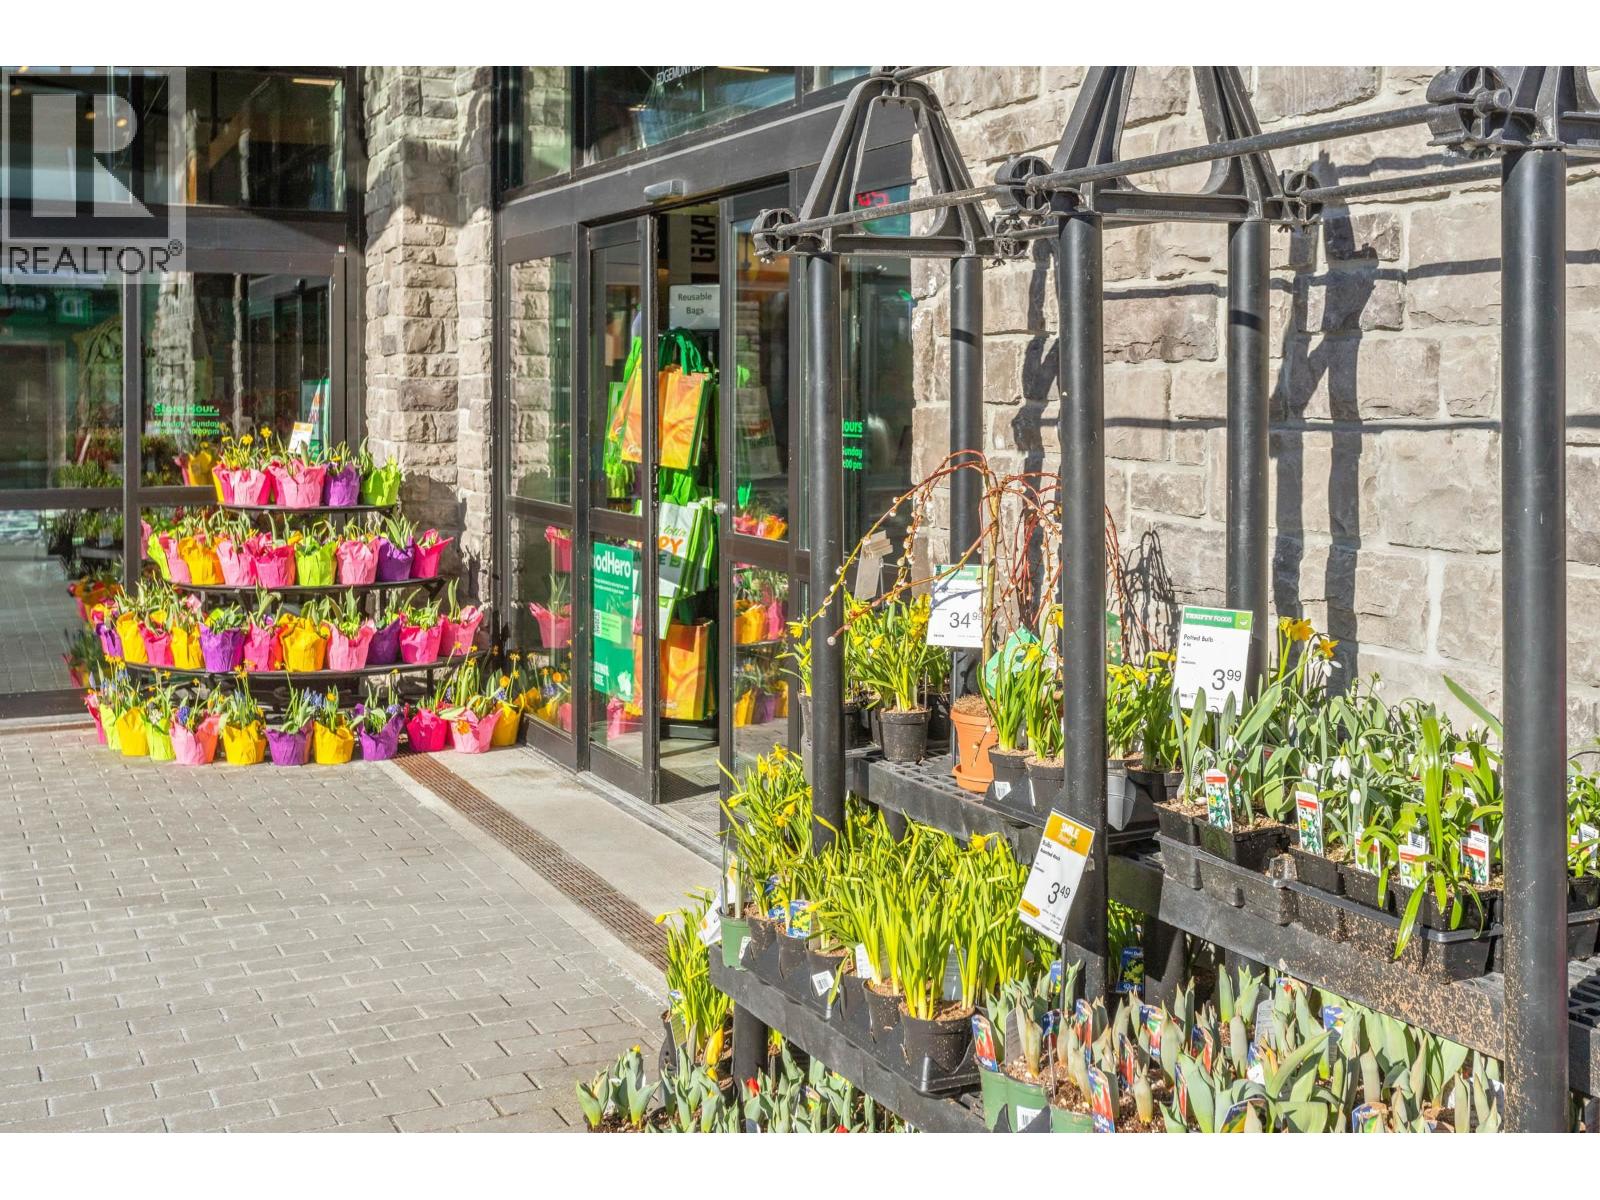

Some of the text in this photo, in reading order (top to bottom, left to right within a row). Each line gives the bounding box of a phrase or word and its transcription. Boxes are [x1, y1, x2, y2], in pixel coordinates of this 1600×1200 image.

[678, 290, 712, 301] Reusable
[686, 306, 704, 317] Bags
[154, 402, 219, 413] Store Hour
[843, 421, 863, 433] ours
[594, 550, 632, 578] odHero
